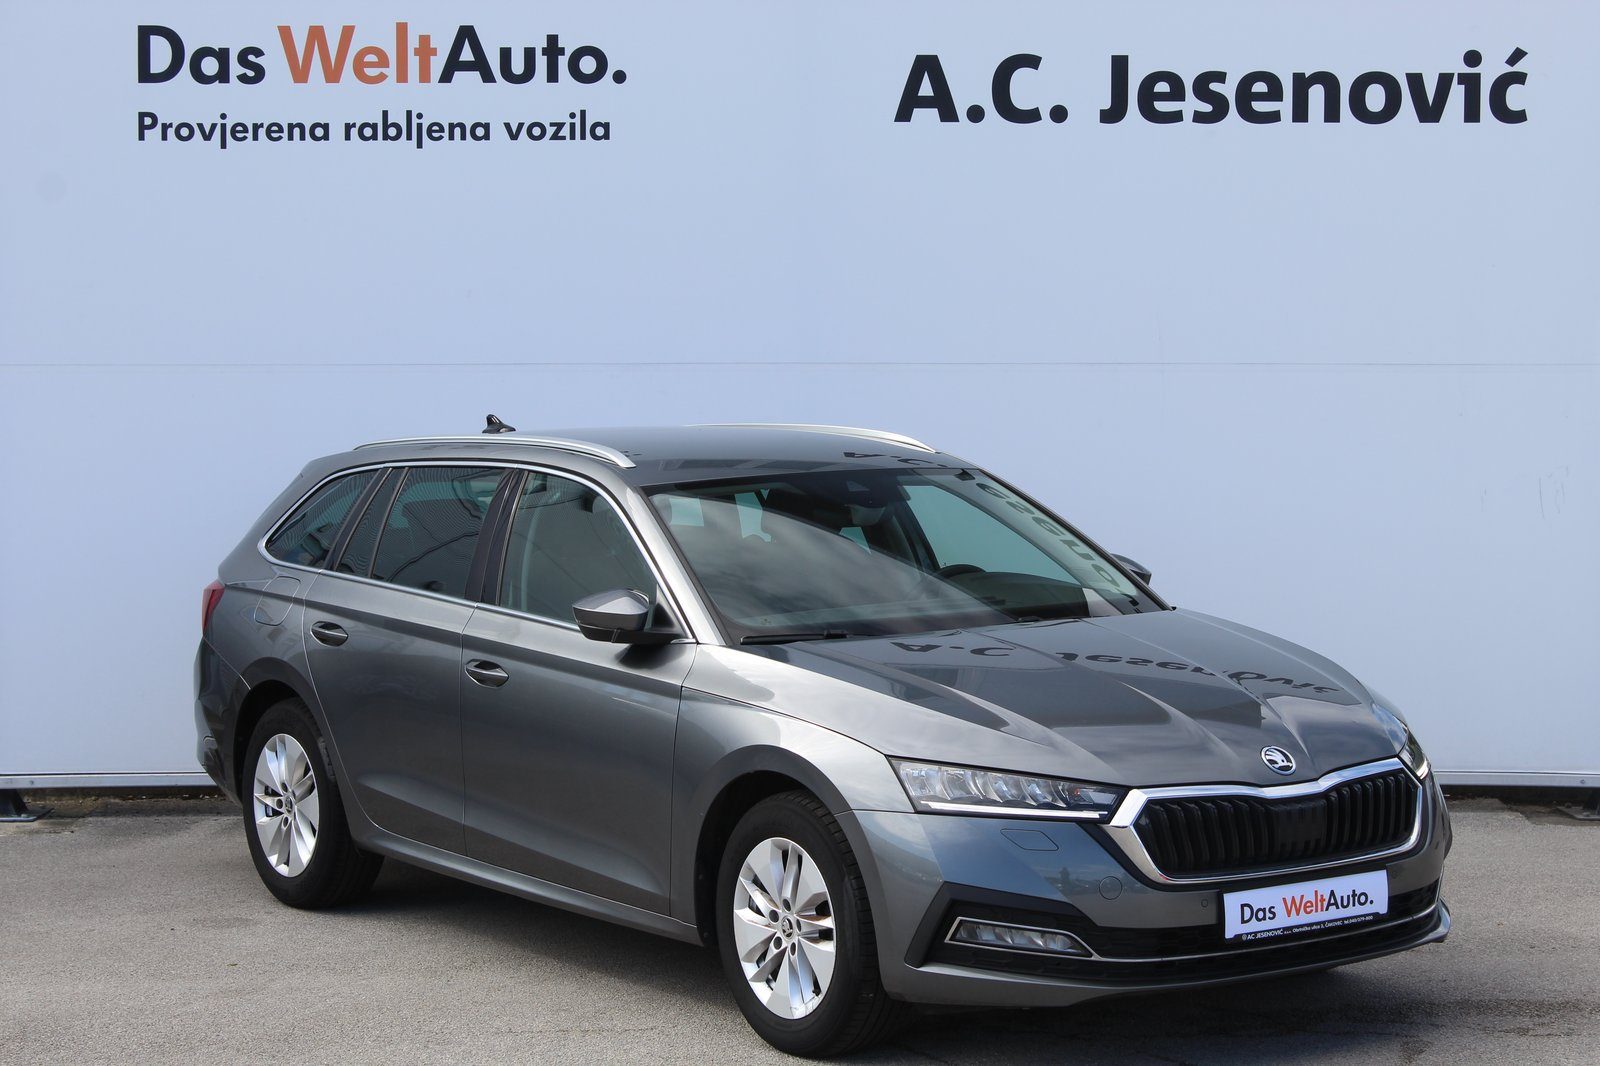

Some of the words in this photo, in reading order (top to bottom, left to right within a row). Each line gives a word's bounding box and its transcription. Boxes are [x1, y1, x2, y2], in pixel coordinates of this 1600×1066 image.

[137, 24, 266, 86] Das
[276, 21, 627, 86] WeltAuto.
[893, 53, 1069, 125] A.C.
[1099, 46, 1530, 126] Jesenović
[137, 111, 330, 150] Provjerena
[344, 109, 491, 150] rabljena
[502, 109, 611, 142] vozila
[1239, 902, 1277, 925] Das
[1282, 889, 1374, 918] WeltAuto.
[1255, 928, 1284, 939] JESENOVIĆ
